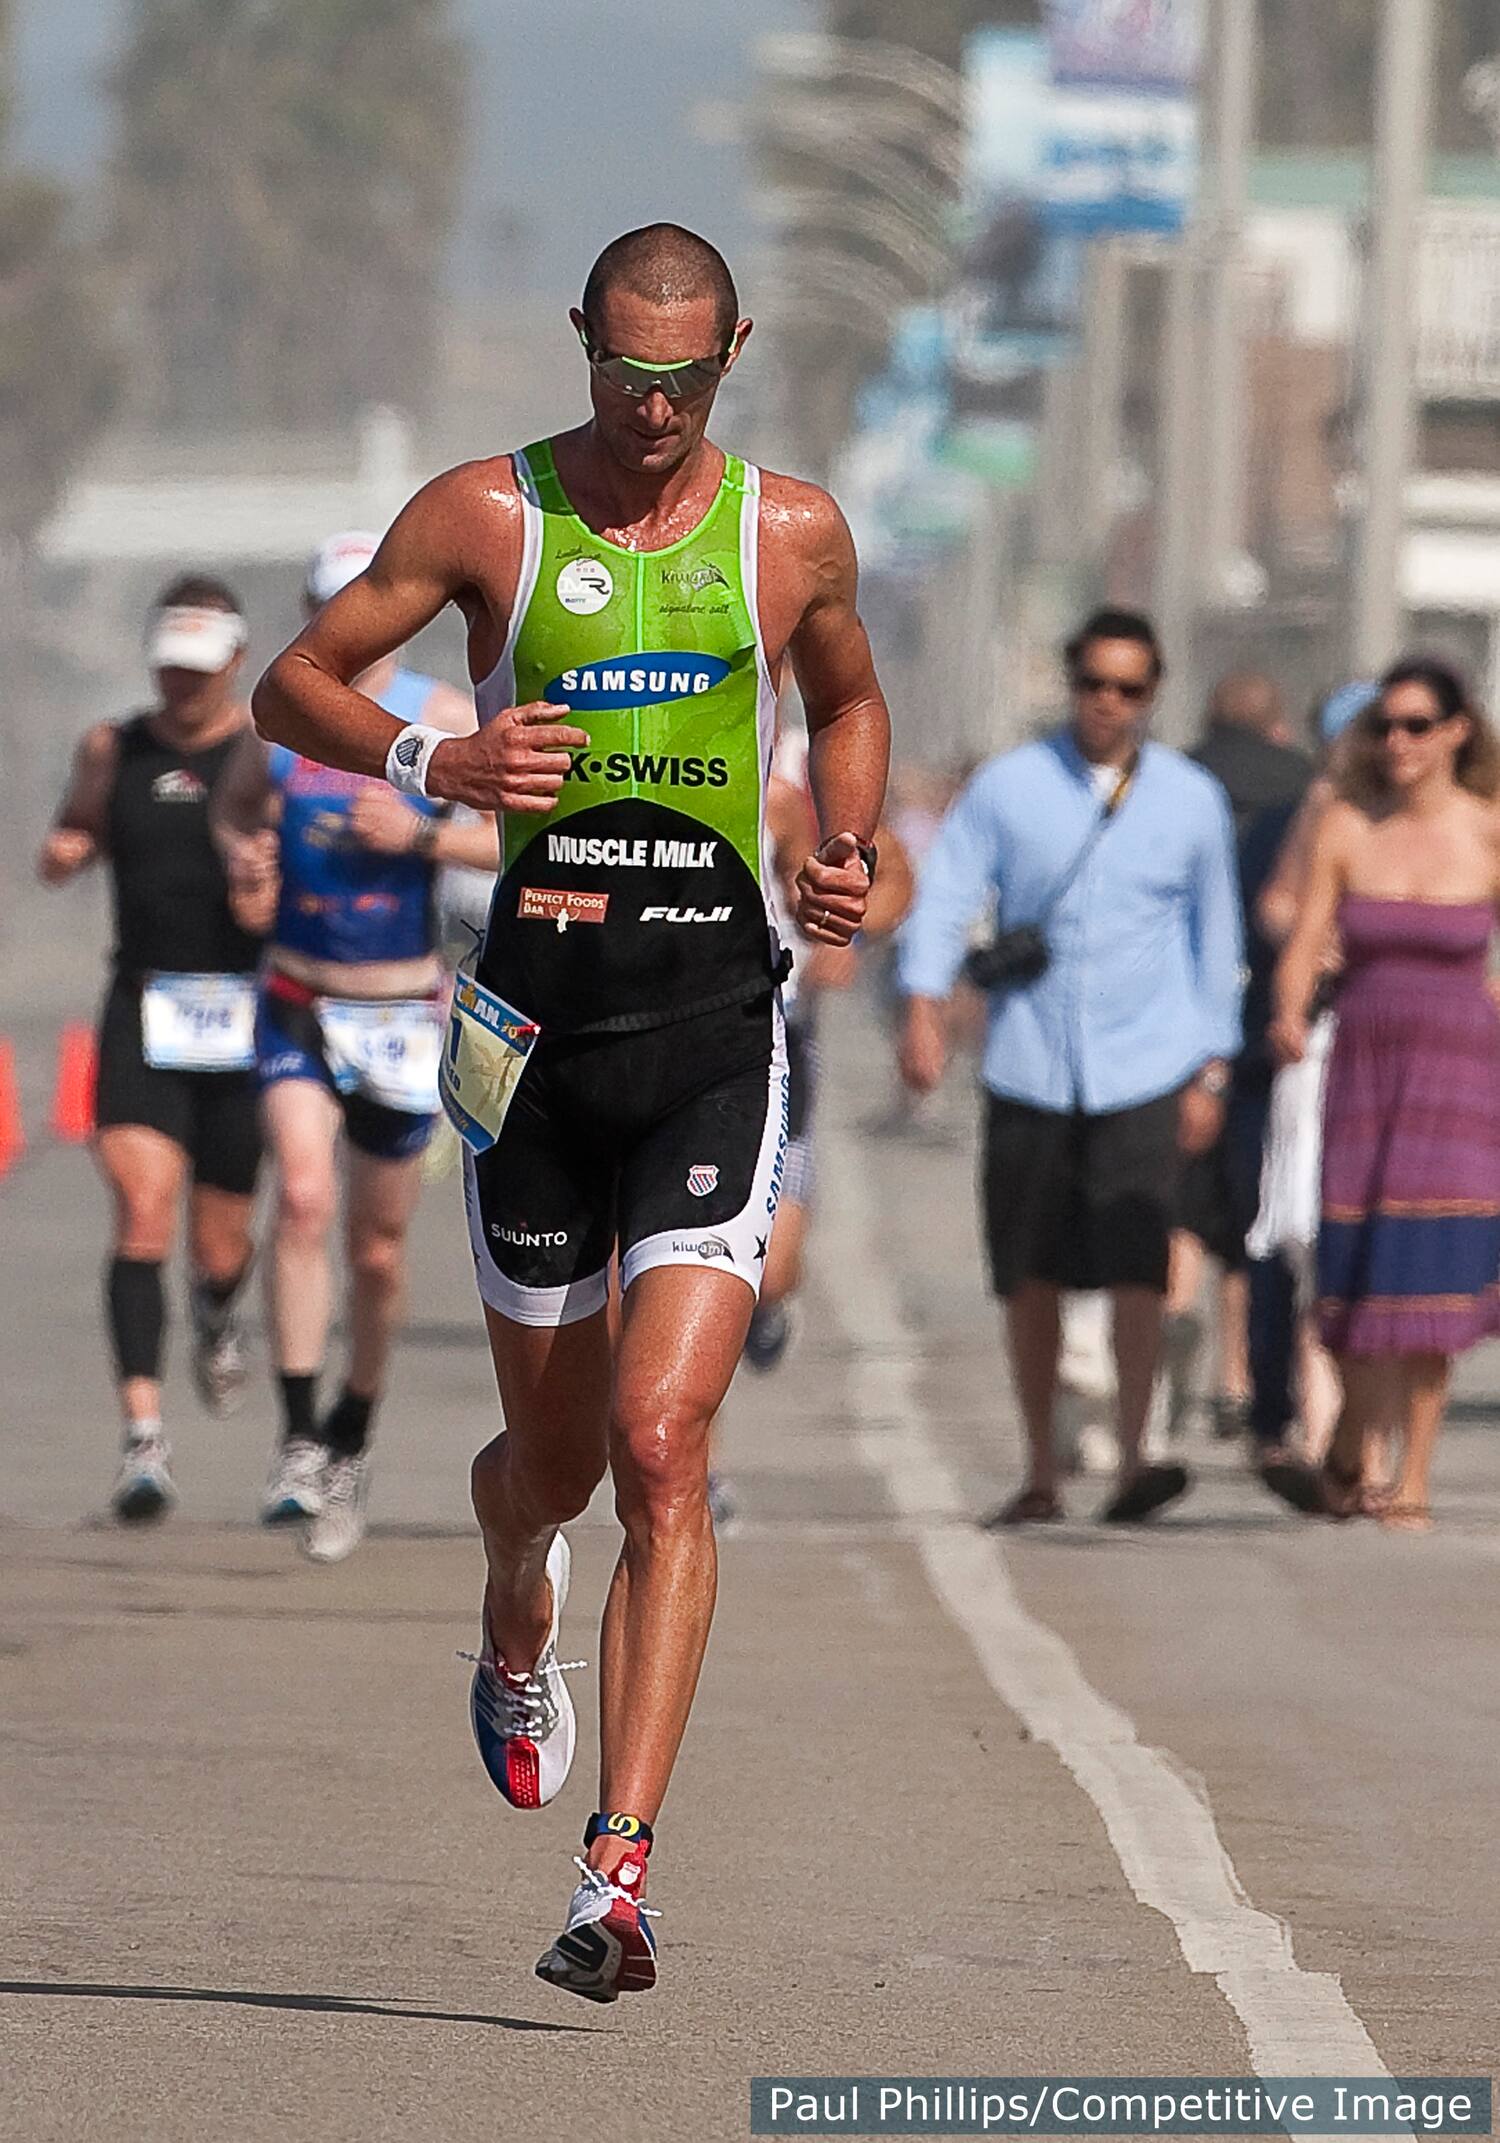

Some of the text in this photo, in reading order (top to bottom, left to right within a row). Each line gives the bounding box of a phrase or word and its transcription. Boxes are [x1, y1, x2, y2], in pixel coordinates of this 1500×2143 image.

[561, 669, 711, 694] SAMSUNG
[548, 834, 718, 868] MUSCLE MILK
[523, 903, 545, 916] BAR
[566, 893, 604, 910] FOODS
[639, 906, 733, 923] FUJI
[491, 1223, 568, 1247] SUUNTO
